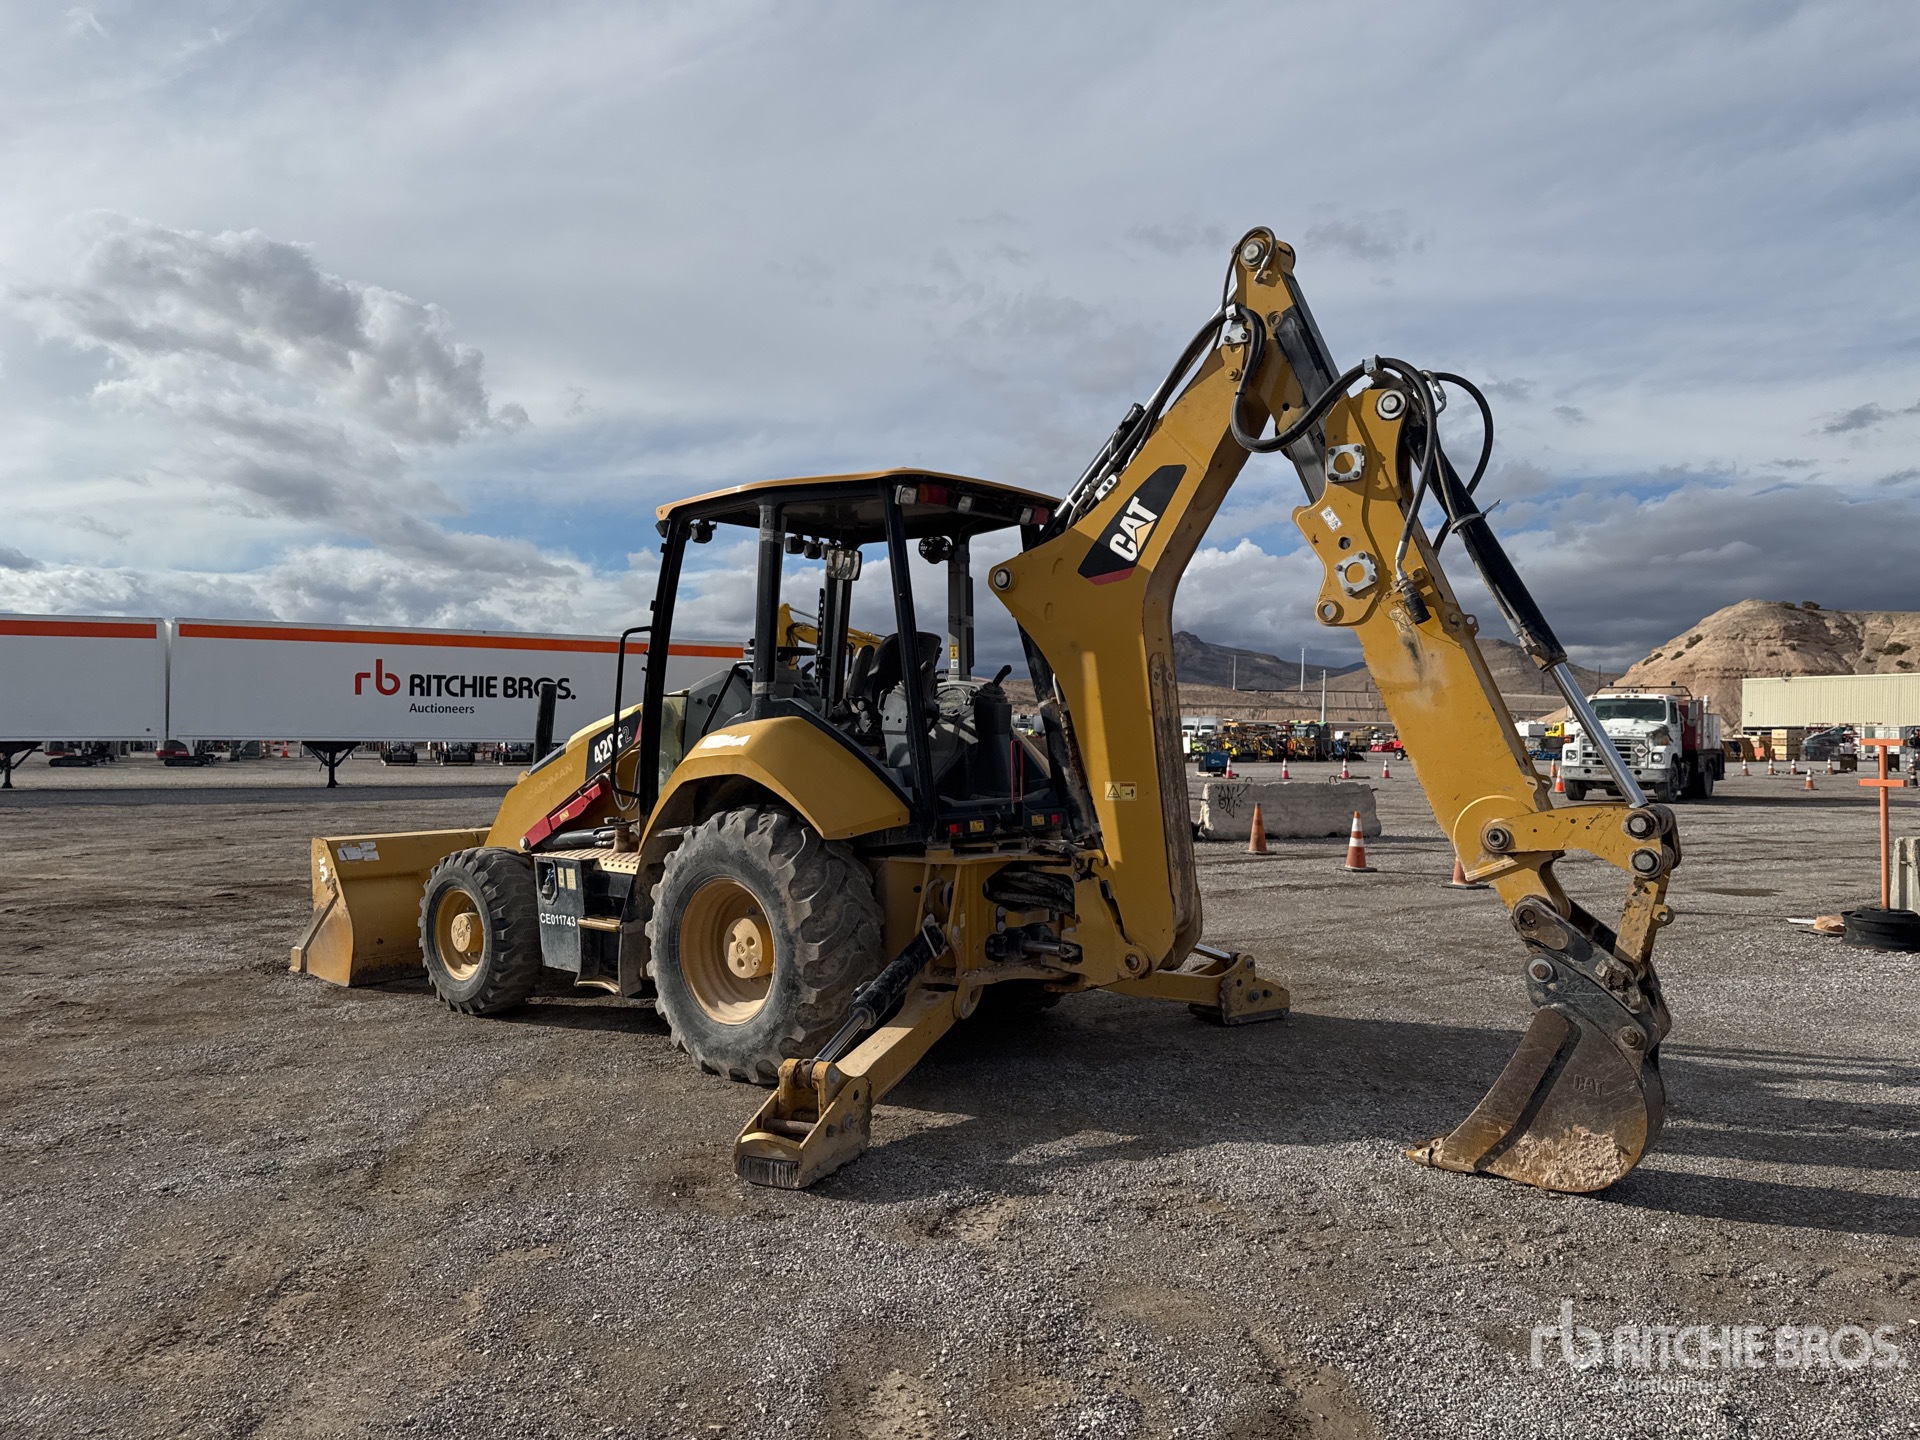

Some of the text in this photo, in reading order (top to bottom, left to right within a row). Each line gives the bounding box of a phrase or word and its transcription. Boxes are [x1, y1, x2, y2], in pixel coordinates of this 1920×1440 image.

[1109, 495, 1158, 562] CAT
[354, 658, 401, 696] rb
[408, 673, 498, 698] RITCHIE
[408, 702, 475, 715] Auctioneers
[540, 912, 576, 927] CE011743
